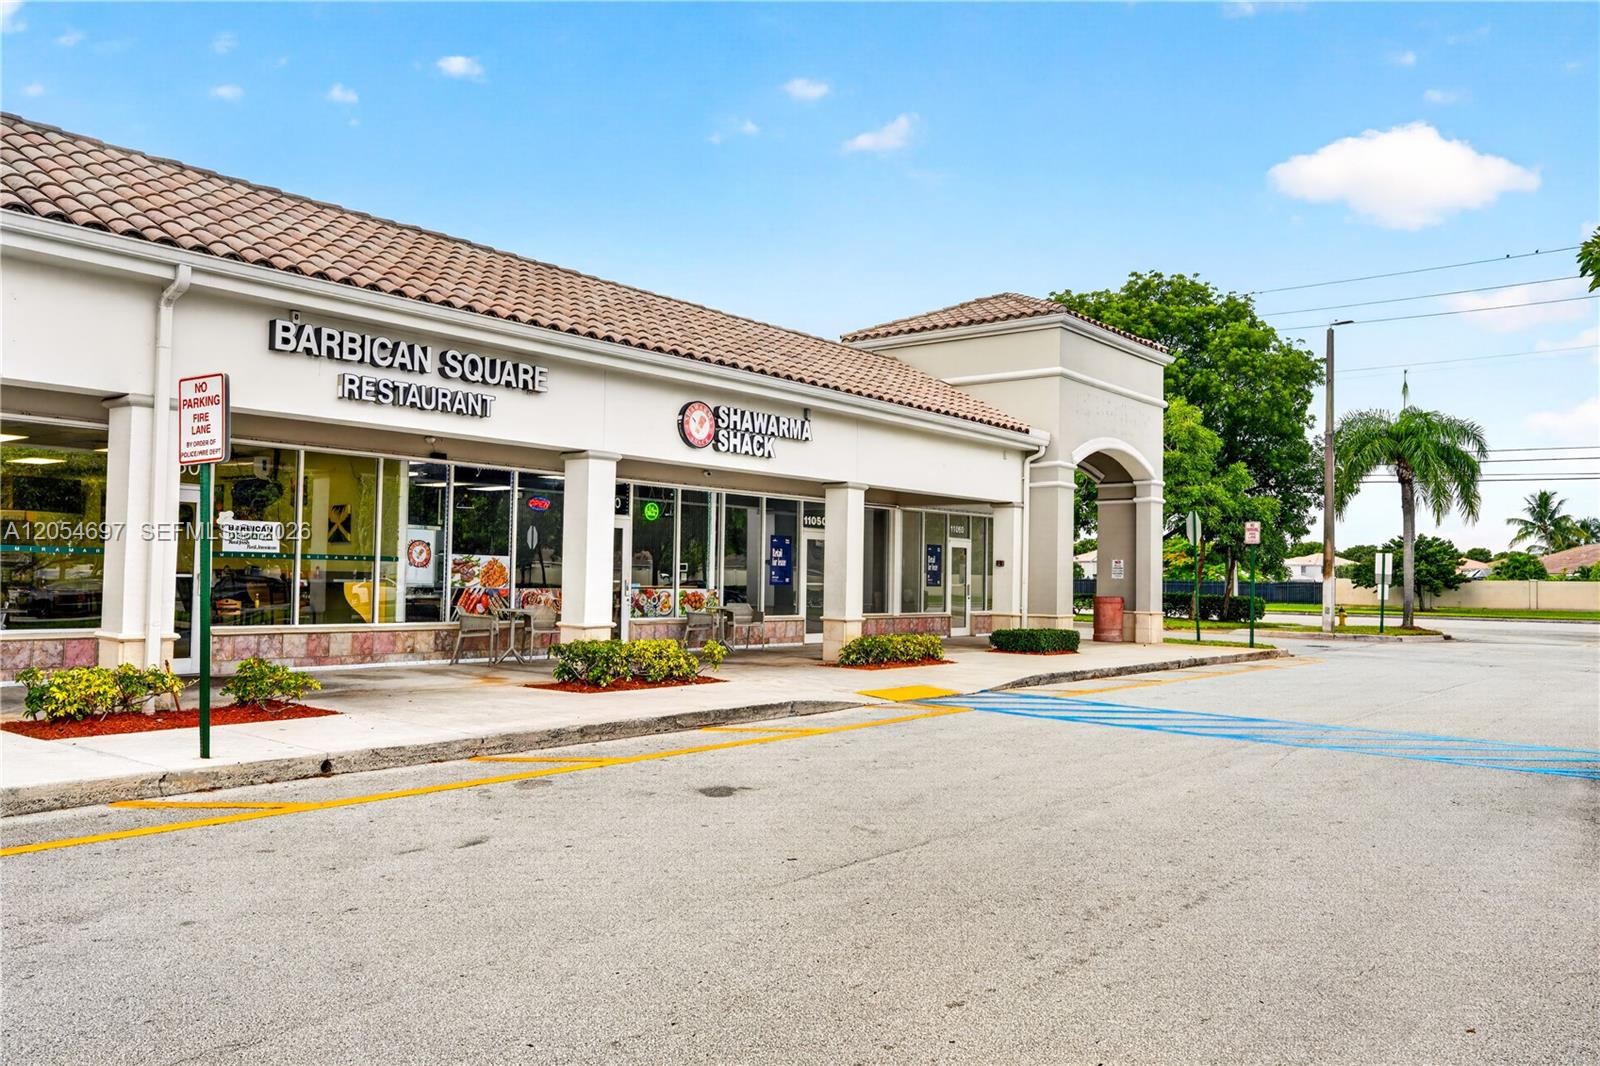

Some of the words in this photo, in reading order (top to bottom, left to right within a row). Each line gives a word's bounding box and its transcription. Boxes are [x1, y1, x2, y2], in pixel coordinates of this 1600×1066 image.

[270, 319, 432, 374] BARBICAN
[440, 349, 549, 393] SQUARE
[194, 381, 208, 393] NO
[338, 373, 496, 417] RESTAURANT
[182, 394, 221, 410] PARKING
[192, 411, 210, 423] FIRE
[716, 405, 813, 442] SHAWARMA
[191, 423, 212, 435] LANE
[193, 439, 208, 447] ORDER
[715, 429, 776, 459] SHACK
